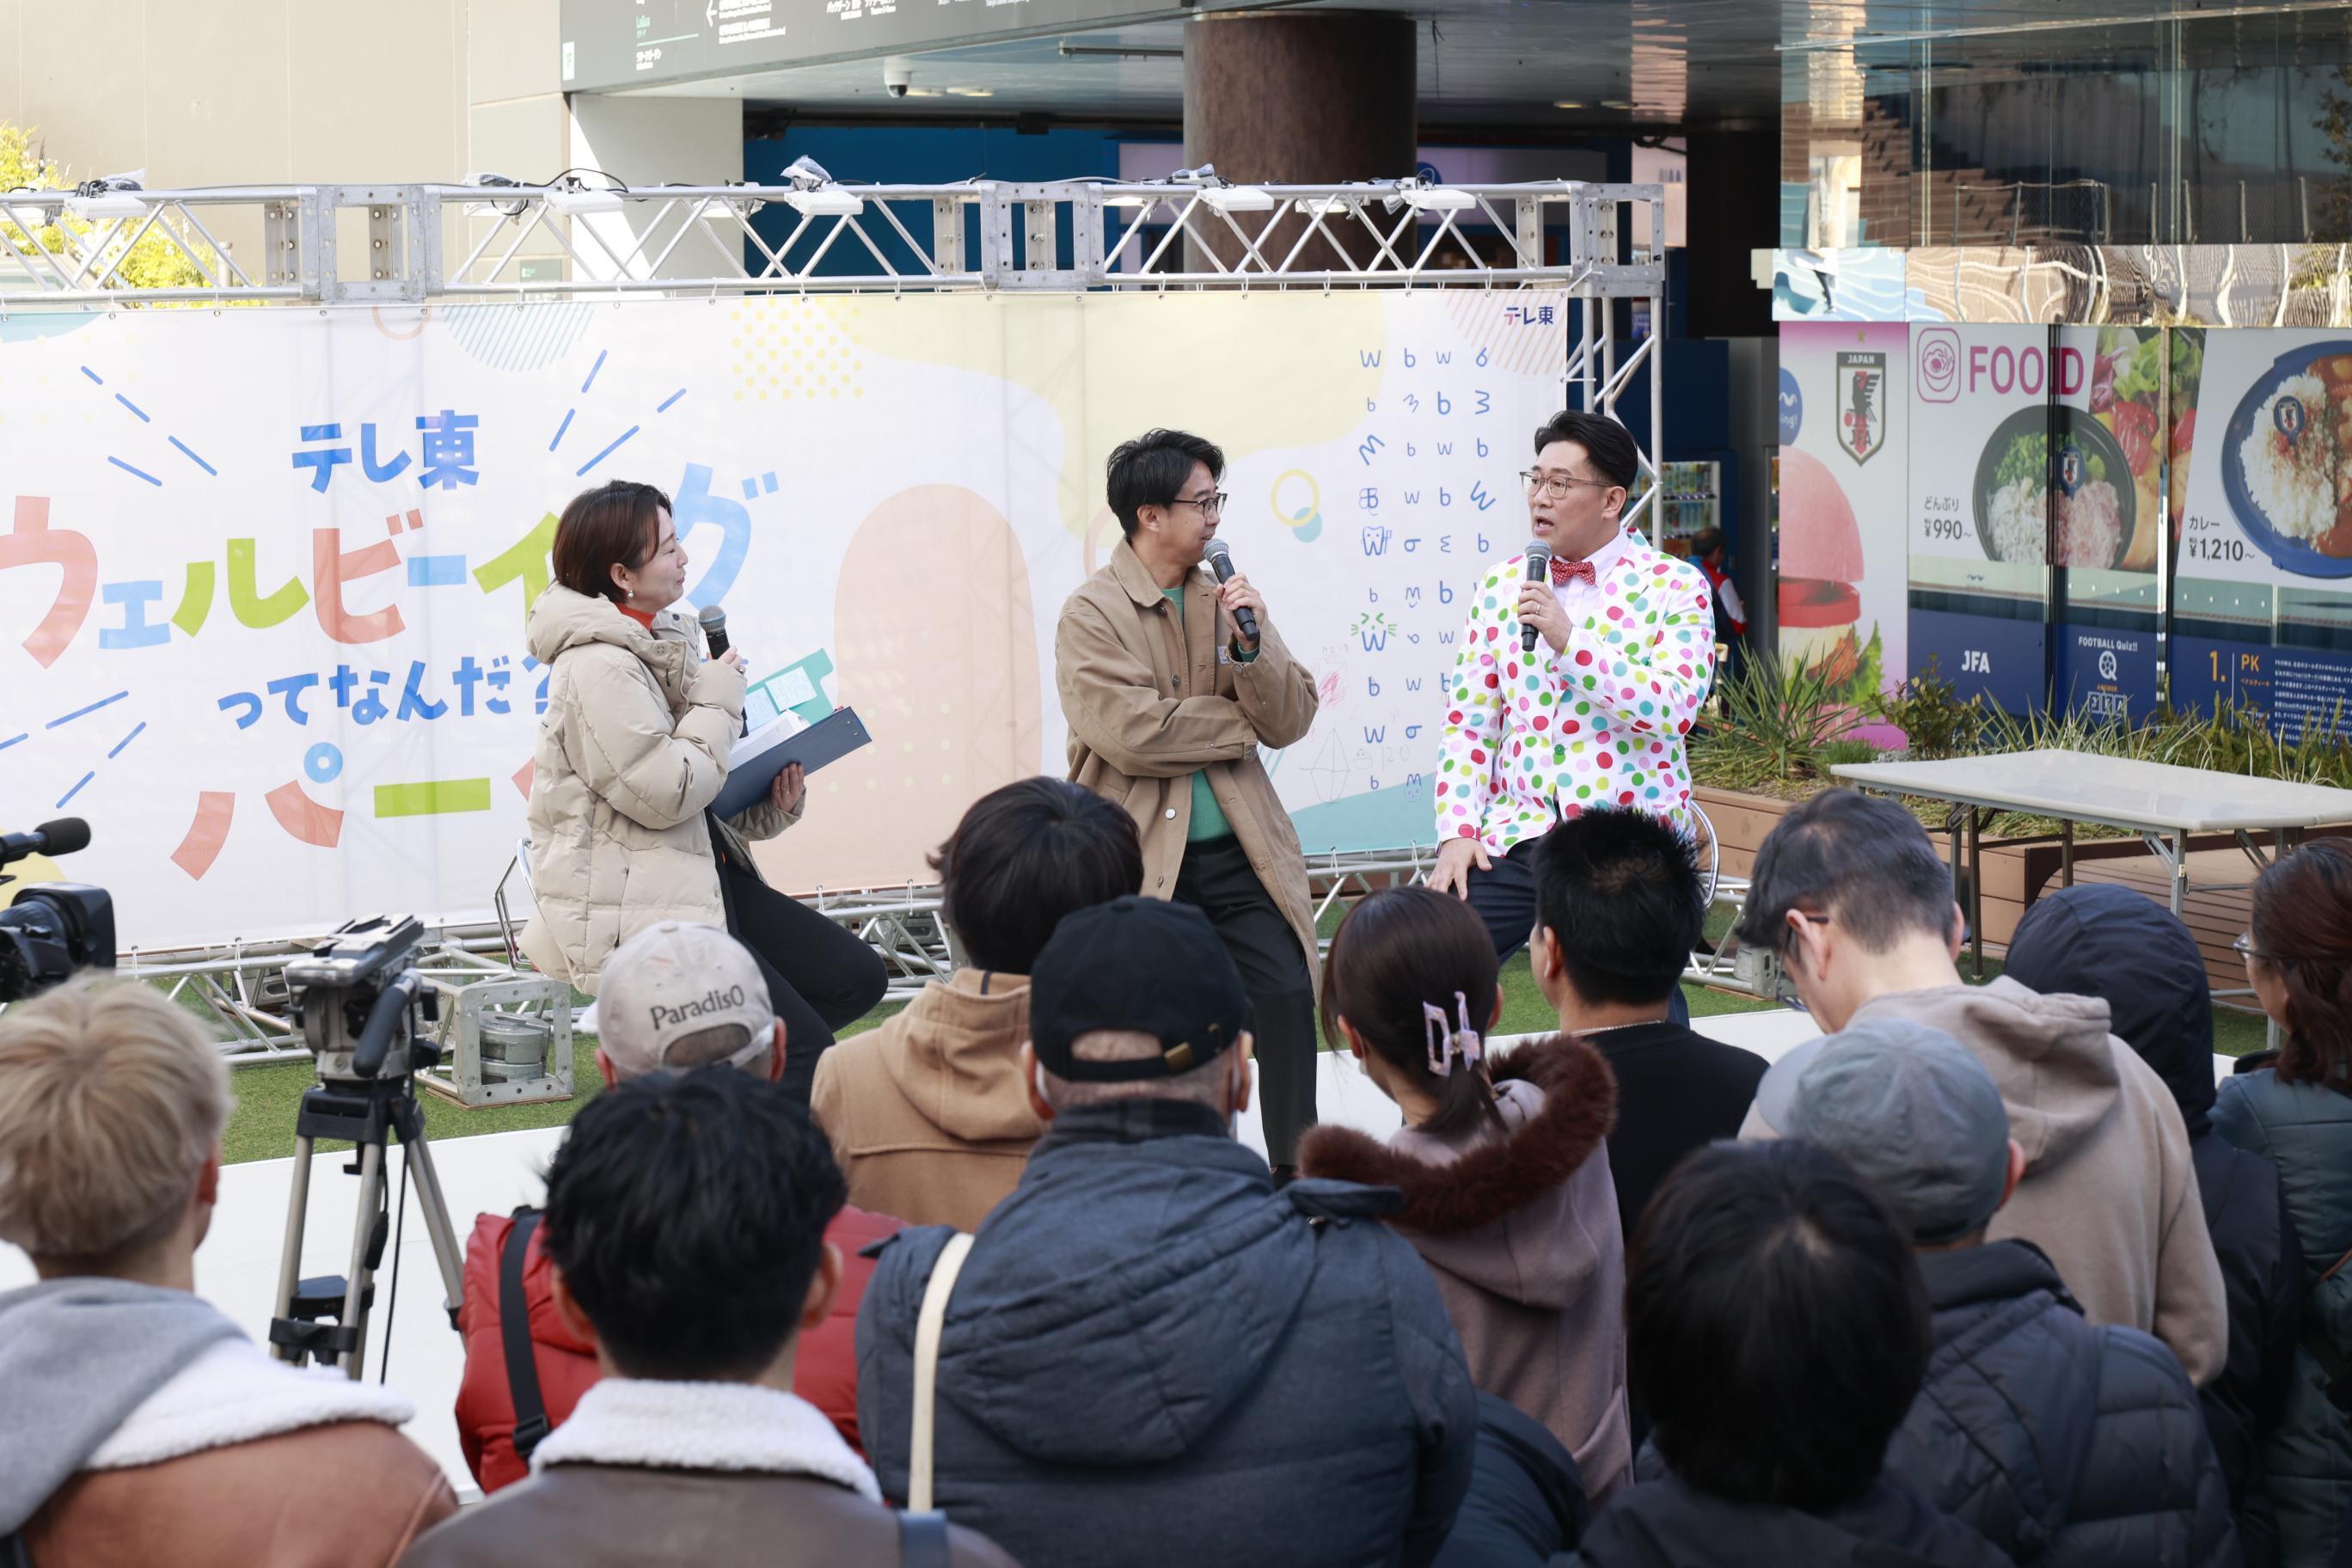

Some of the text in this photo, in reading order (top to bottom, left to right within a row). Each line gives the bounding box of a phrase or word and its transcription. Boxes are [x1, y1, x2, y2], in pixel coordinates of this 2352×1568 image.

[1504, 306, 1554, 326] テレ東
[1847, 354, 1875, 364] JAPAN
[1969, 346, 2084, 395] FOOD
[1849, 429, 1872, 447] JFA
[292, 408, 479, 494] テレ東
[1924, 496, 1959, 511] どんぶり
[2189, 515, 2220, 530] カレー
[0, 462, 779, 669] ウェルビーイグ
[2079, 636, 2138, 652] FOOTBALL Quiz!!
[1962, 650, 1991, 674] JFA
[2210, 650, 2226, 683] 1.
[2241, 653, 2260, 672] PK
[170, 741, 537, 880] パー
